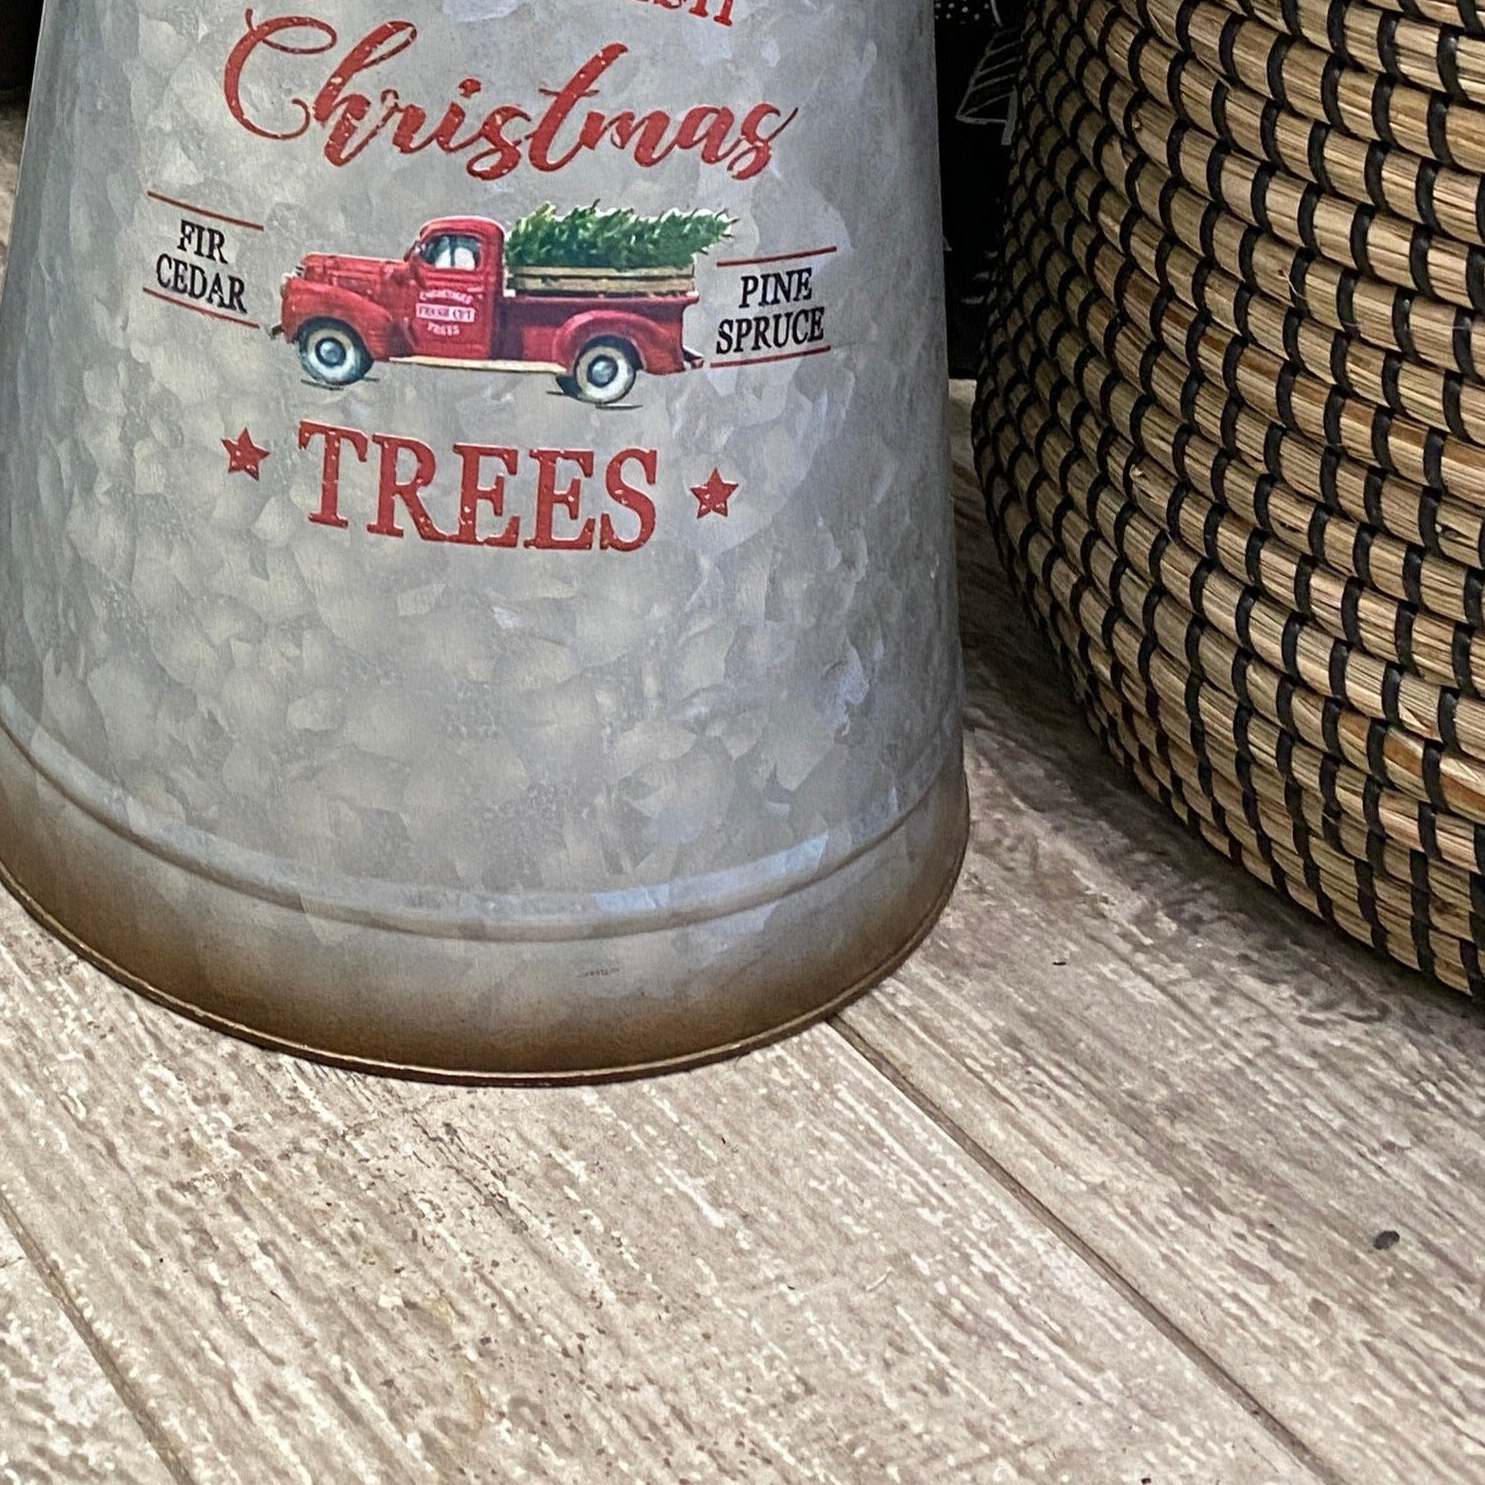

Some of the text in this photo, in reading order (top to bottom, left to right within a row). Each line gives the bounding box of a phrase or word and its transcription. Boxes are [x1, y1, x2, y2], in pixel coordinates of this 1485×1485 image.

[222, 8, 799, 182] Christmas
[176, 219, 229, 265] FIR
[154, 254, 248, 314] CEDAR
[739, 268, 813, 309] PINE
[715, 306, 825, 355] SPRUCE
[298, 419, 658, 552] TREES
